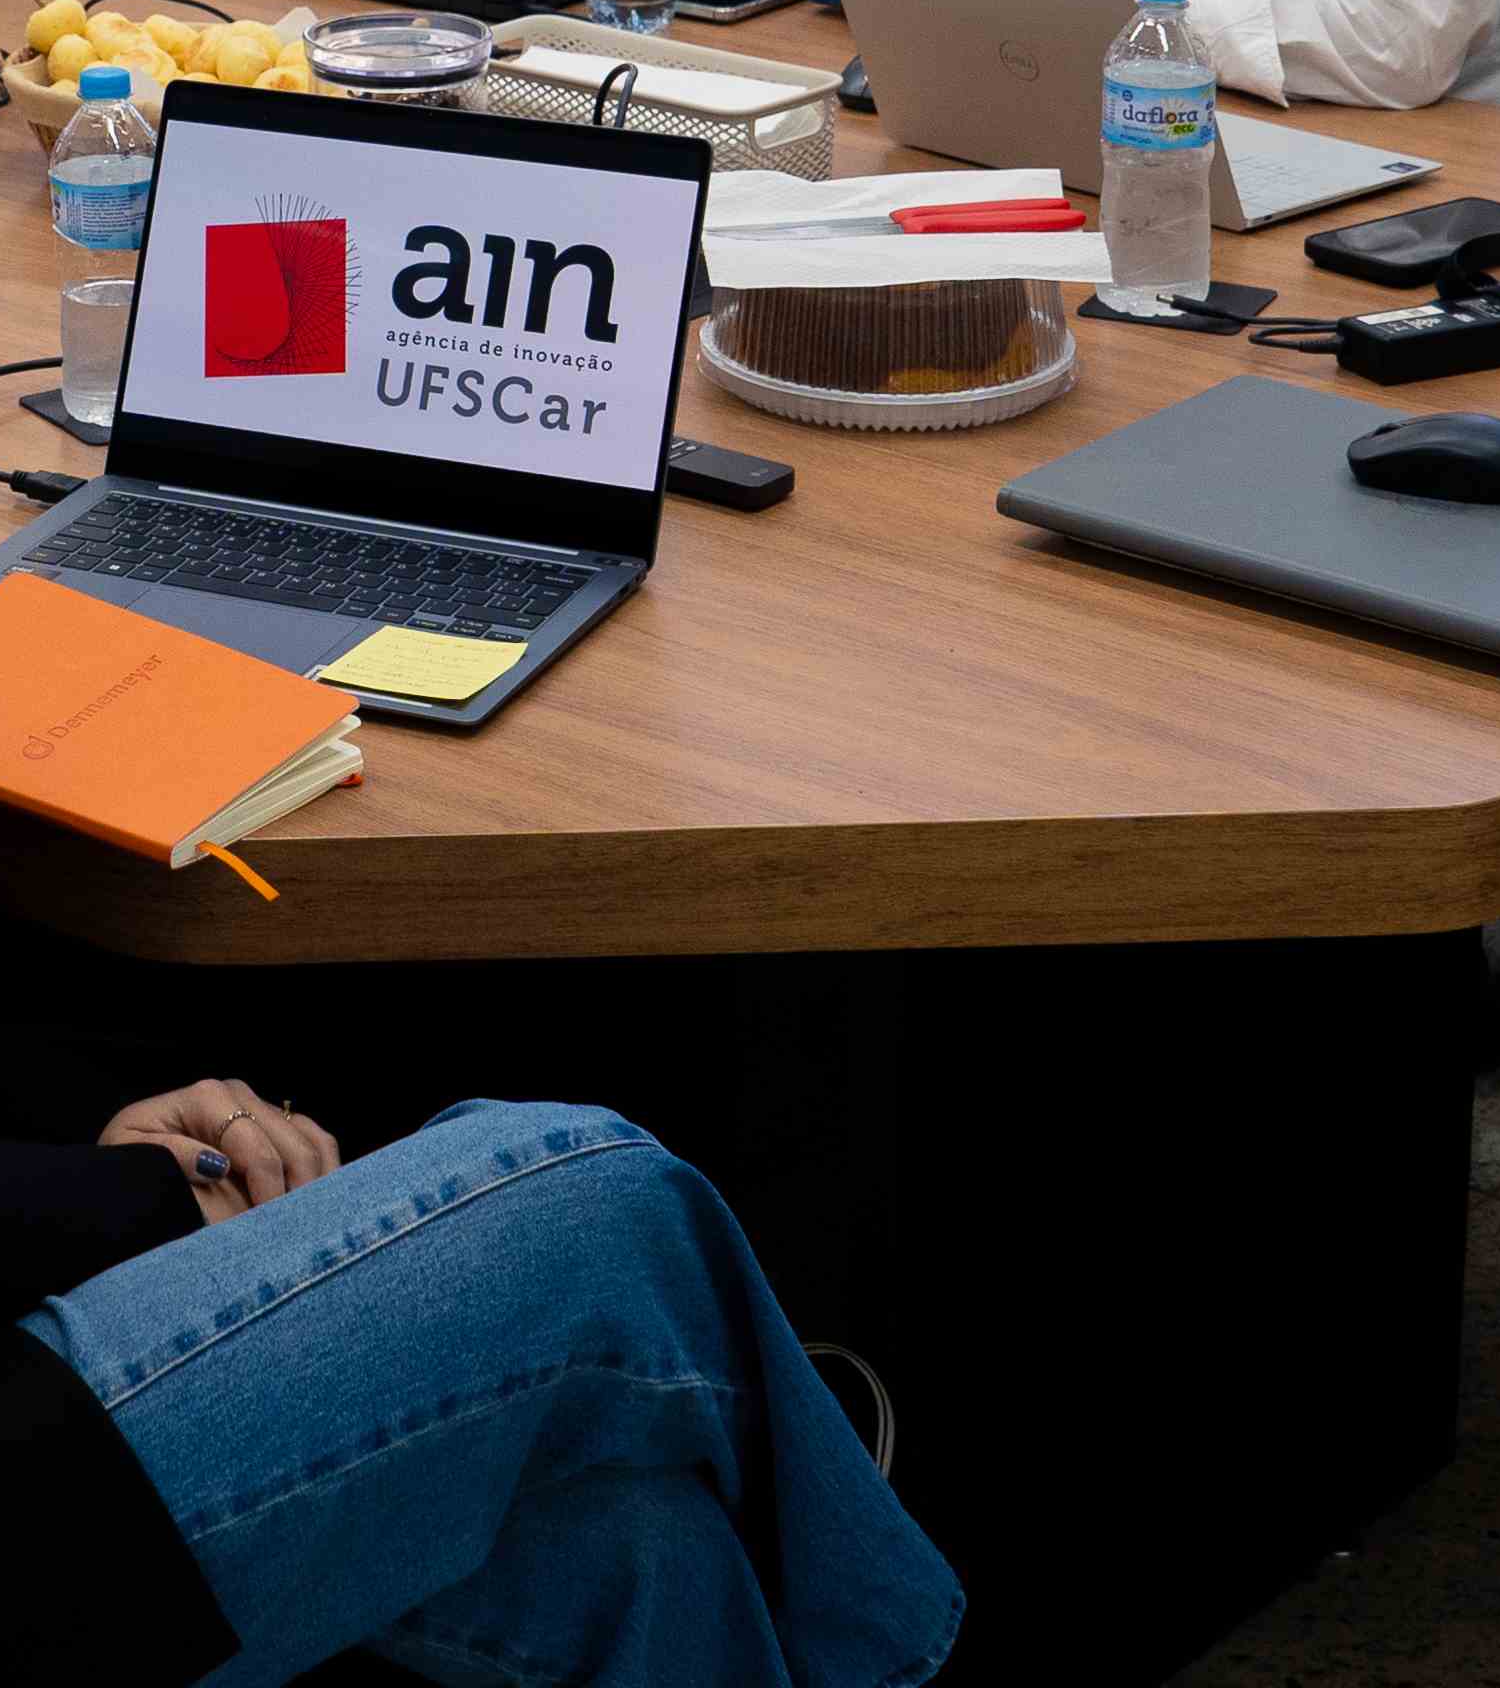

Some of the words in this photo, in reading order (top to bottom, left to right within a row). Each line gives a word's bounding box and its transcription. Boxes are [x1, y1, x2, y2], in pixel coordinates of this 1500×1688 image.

[1122, 104, 1199, 124] daflora
[385, 329, 469, 352] agência
[479, 339, 503, 357] de
[513, 345, 613, 372] inovação
[376, 357, 607, 435] UFSCar
[47, 653, 163, 739] Dennemeyer
